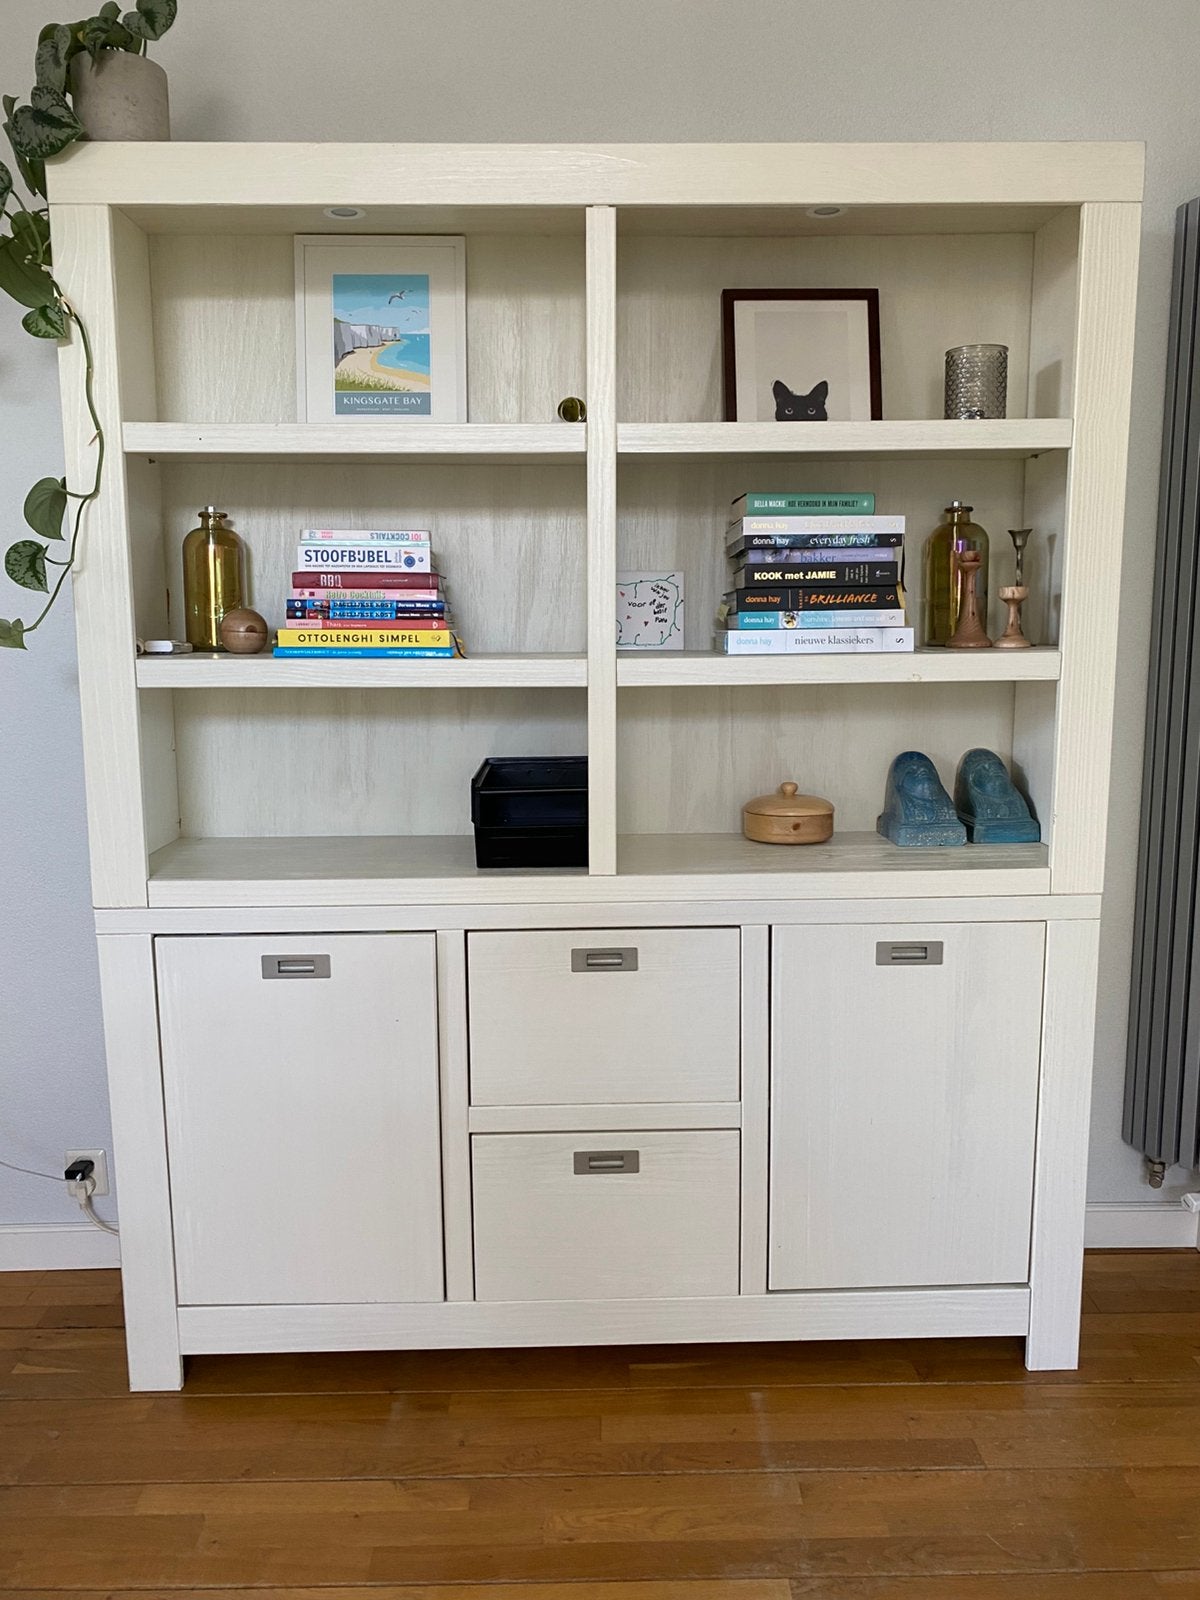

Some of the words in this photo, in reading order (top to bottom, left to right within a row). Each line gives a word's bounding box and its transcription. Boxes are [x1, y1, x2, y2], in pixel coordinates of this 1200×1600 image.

[343, 396, 400, 405] KINGSGATE
[403, 396, 422, 405] BAY
[754, 500, 768, 508] BELLA
[769, 500, 785, 508] MACKIE
[751, 521, 775, 530] donna
[775, 521, 788, 531] hay
[370, 532, 410, 541] COCKTAILS
[752, 536, 775, 545] donna
[775, 536, 789, 546] hay
[809, 534, 847, 546] everyday
[848, 534, 871, 545] fresh
[800, 552, 836, 563] bakker
[754, 571, 783, 580] KOOK
[784, 571, 804, 580] met
[805, 570, 837, 580] JAMIE
[320, 574, 343, 589] BBQ
[325, 590, 347, 599] Retro
[350, 590, 386, 599] Cocktails
[745, 595, 768, 604] donna
[768, 595, 781, 604] hay
[809, 593, 878, 605] BRILLIANCE
[375, 601, 393, 609] KOST
[743, 616, 764, 624] donna
[764, 616, 775, 625] hay
[298, 633, 373, 643] OTTOLENGHI
[379, 634, 420, 643] SIMPEL
[736, 636, 758, 645] donna
[758, 636, 772, 646] hay
[794, 636, 827, 645] nieuwe
[827, 635, 875, 645] klassiekers
